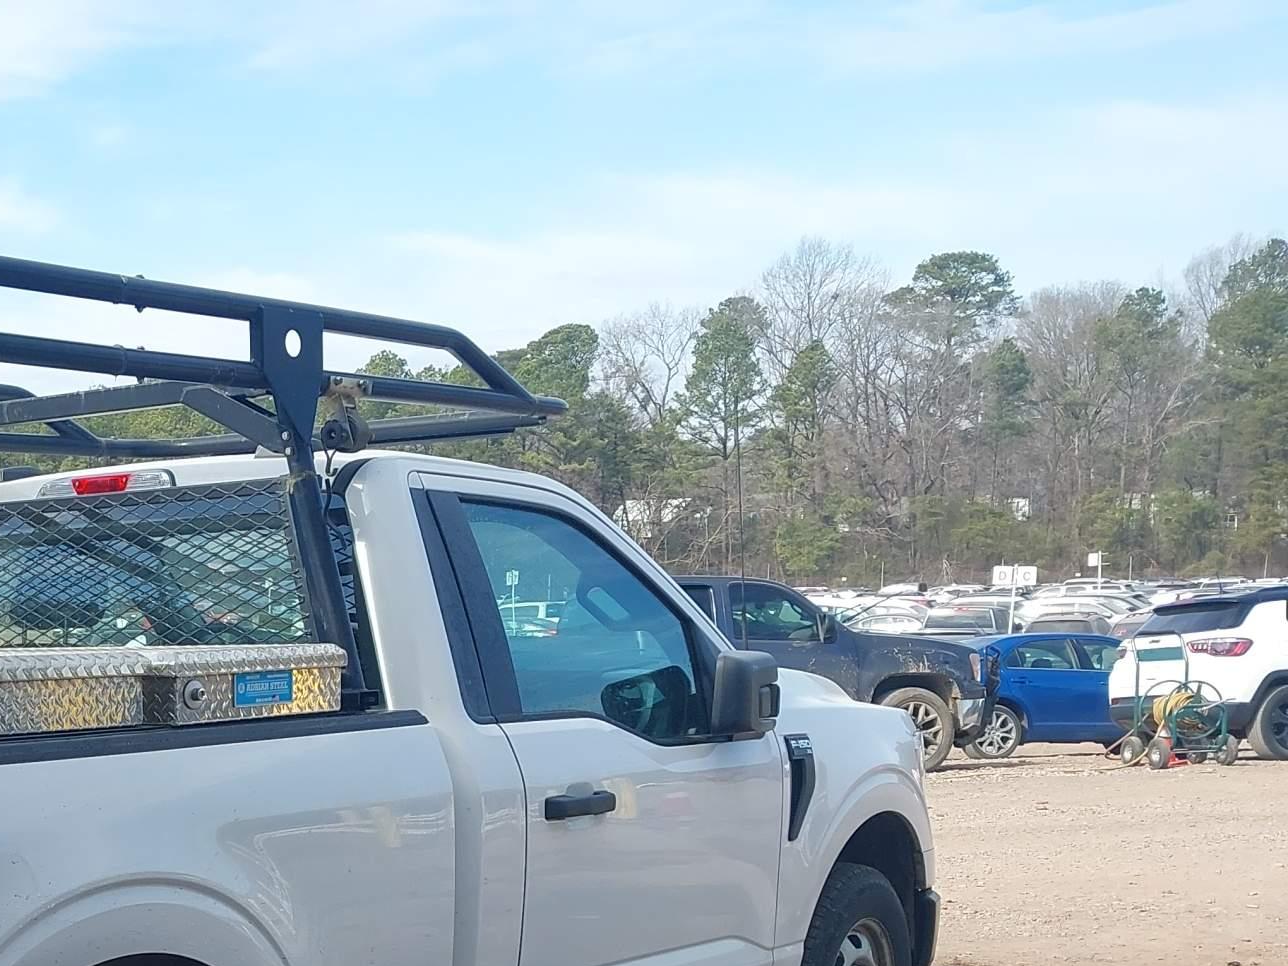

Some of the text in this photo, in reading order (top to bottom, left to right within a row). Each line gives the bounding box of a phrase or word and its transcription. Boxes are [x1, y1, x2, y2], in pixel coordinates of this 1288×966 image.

[998, 571, 1007, 580] D
[1022, 571, 1031, 581] C
[246, 680, 289, 692] ADRIAN STEEL
